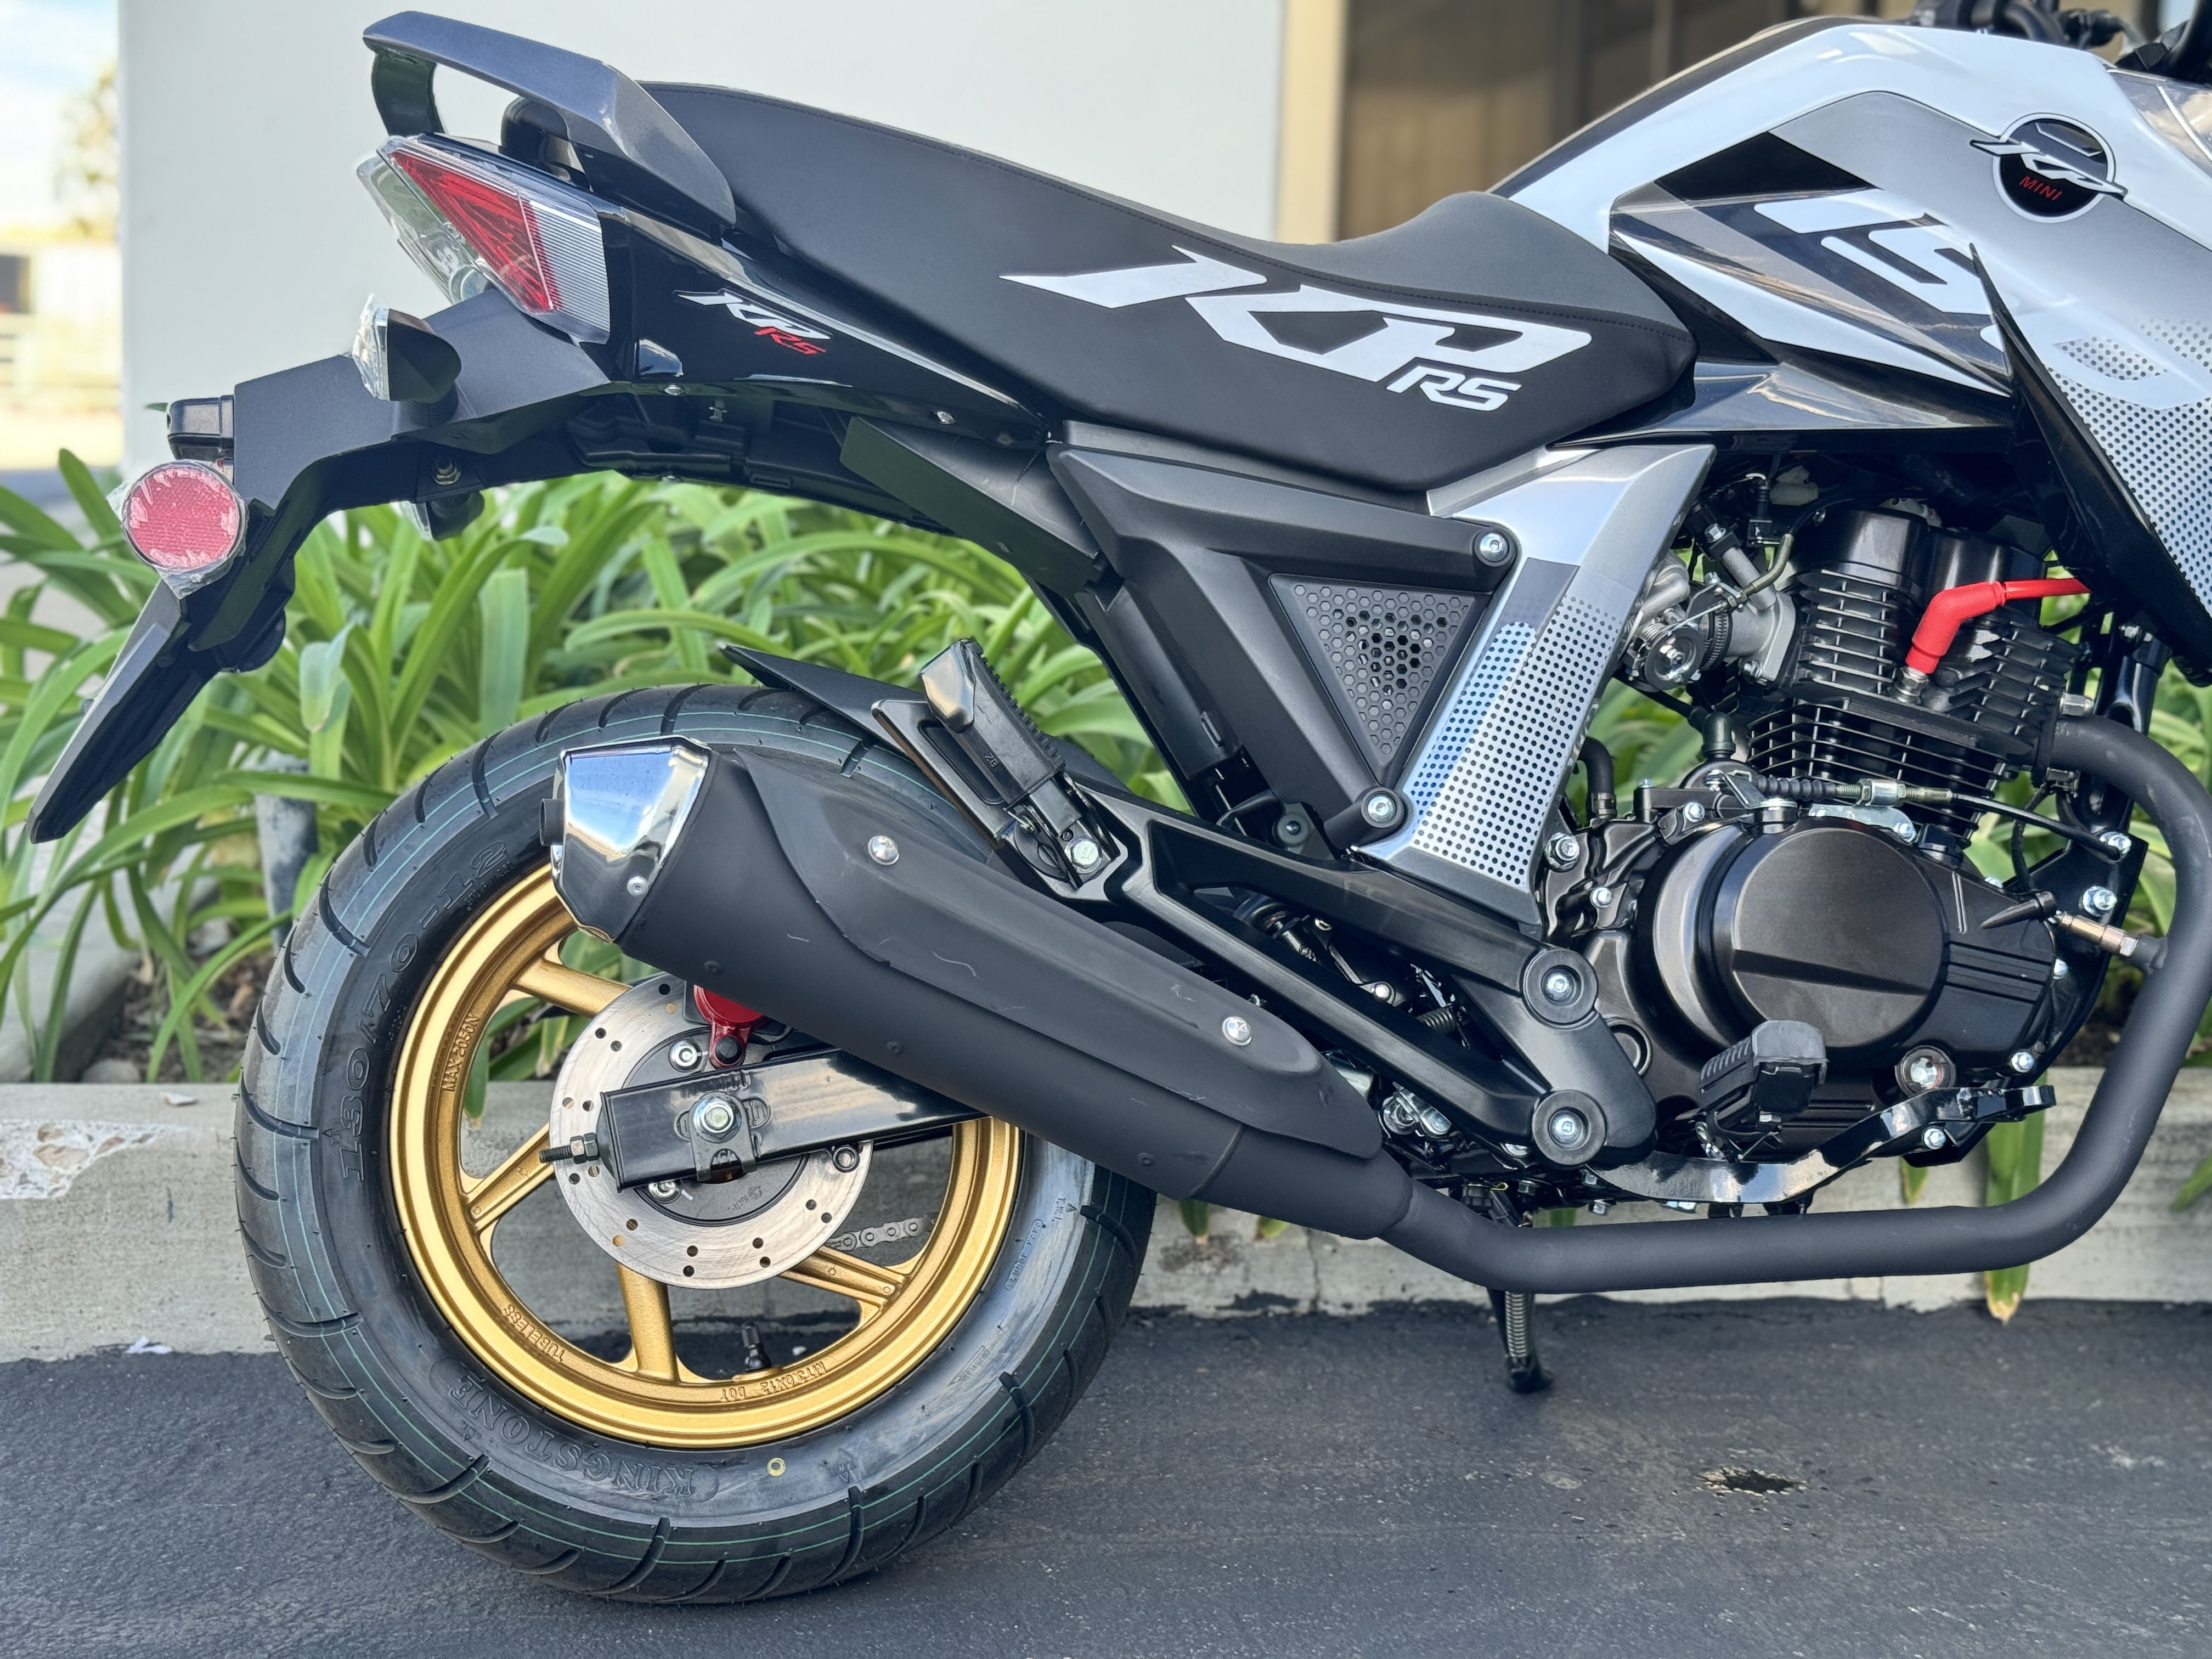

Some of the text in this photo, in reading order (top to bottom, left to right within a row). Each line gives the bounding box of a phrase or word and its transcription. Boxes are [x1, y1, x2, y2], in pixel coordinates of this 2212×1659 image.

[2019, 176, 2062, 201] MINI
[754, 326, 826, 355] RS
[1386, 365, 1522, 412] RS
[442, 1013, 480, 1092] MAX 2050N
[503, 1304, 567, 1363] TUBELESS
[719, 1386, 746, 1402] DOT
[448, 1374, 696, 1497] KINGSTONE
